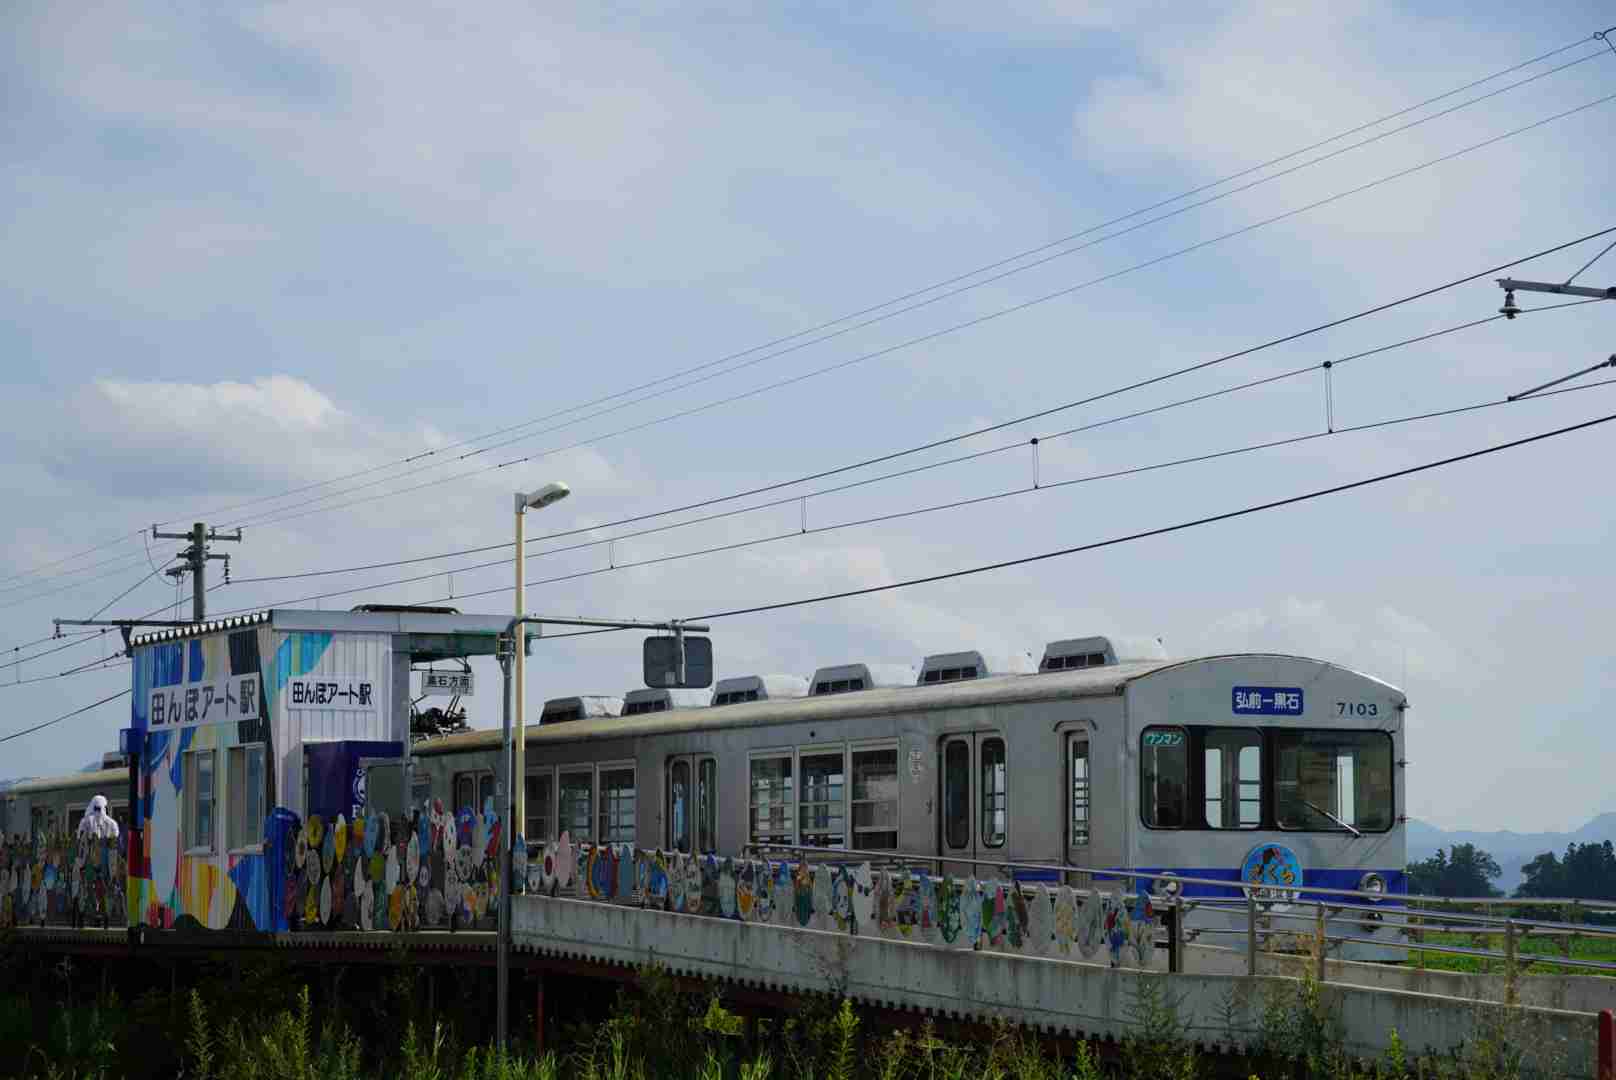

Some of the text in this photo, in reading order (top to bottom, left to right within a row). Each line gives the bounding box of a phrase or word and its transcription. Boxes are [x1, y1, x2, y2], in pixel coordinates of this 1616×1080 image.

[152, 679, 255, 725] 田んぼアート駅
[293, 682, 371, 704] 田んぼアート駅
[1336, 702, 1377, 716] 7103
